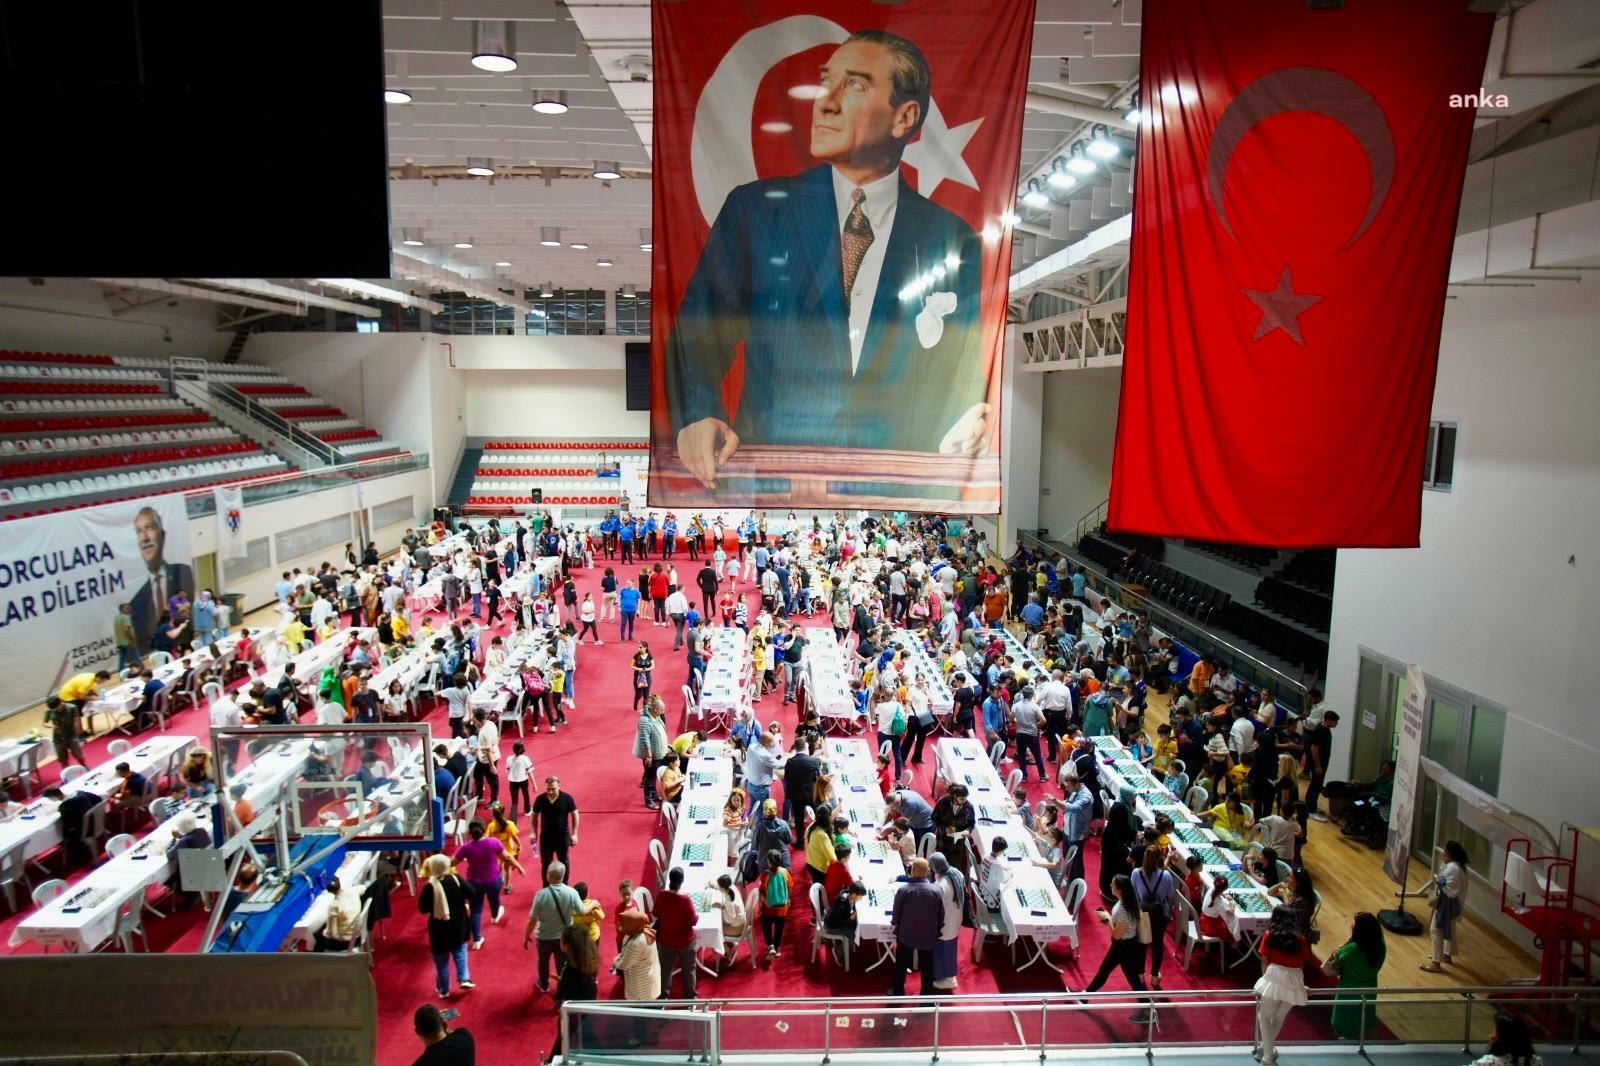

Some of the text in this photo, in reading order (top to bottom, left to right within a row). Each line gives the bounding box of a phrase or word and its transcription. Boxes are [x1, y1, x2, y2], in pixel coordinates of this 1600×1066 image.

[41, 568, 125, 613] DİLERİM
[72, 635, 114, 659] ZEYDAN
[74, 650, 119, 671] KARALA
